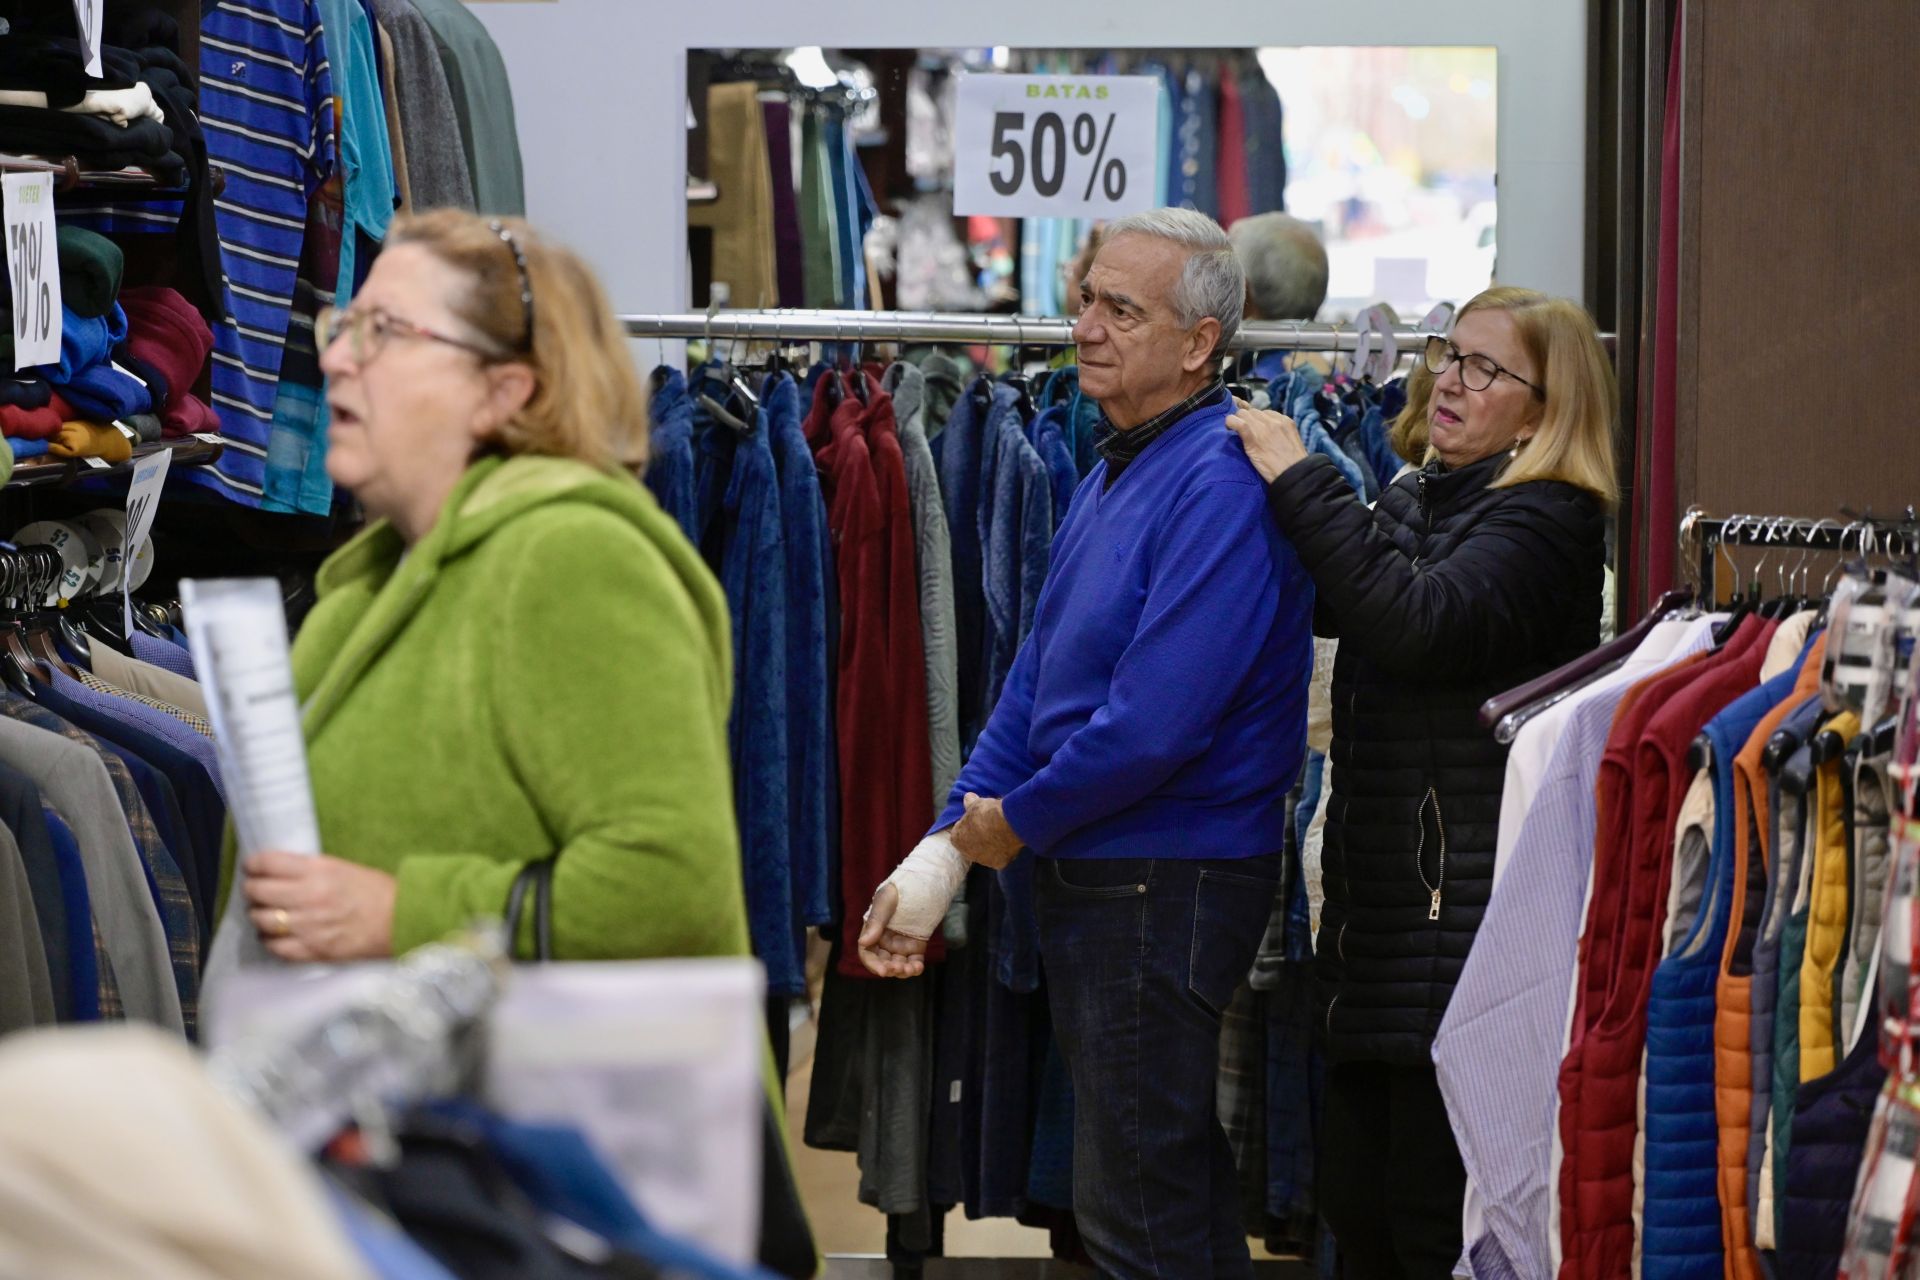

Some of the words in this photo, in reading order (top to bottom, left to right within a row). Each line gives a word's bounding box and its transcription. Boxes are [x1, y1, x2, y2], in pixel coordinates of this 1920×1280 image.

[1026, 84, 1109, 99] BATAS
[989, 112, 1126, 202] 50%
[50, 528, 69, 547] 52
